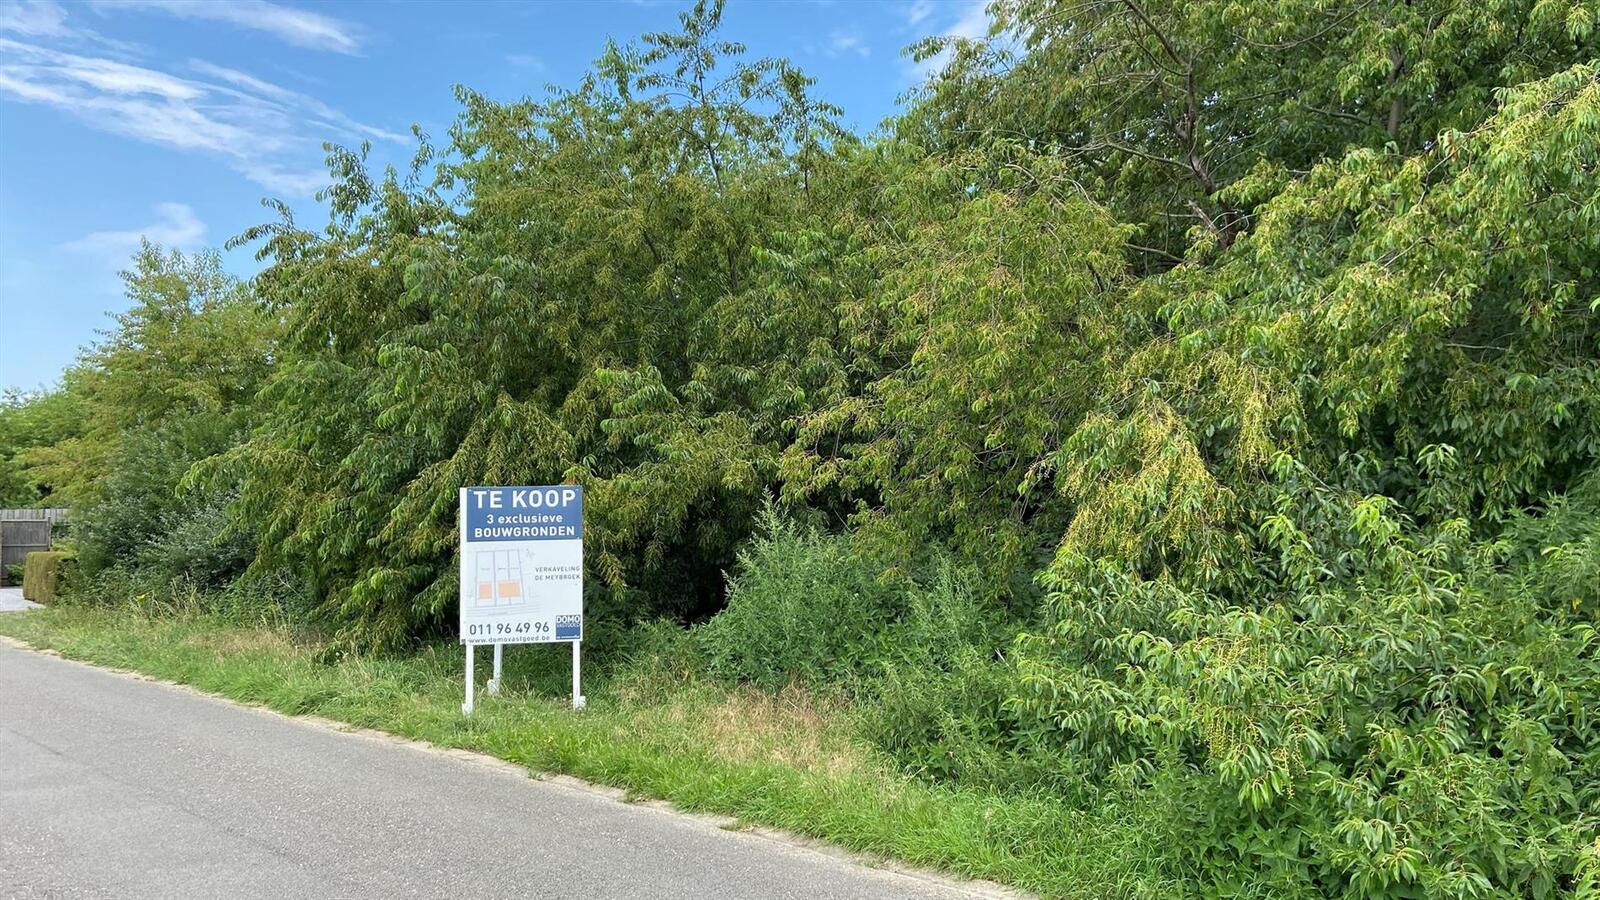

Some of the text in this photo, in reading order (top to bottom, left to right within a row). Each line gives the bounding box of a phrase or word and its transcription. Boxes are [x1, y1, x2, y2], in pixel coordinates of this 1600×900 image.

[474, 489, 576, 508] TE KOOP
[487, 513, 563, 524] 3 exclusieve
[474, 526, 575, 538] BOUWGRONDEN
[556, 615, 580, 623] DOMO
[469, 622, 550, 635] 011 96 49 96
